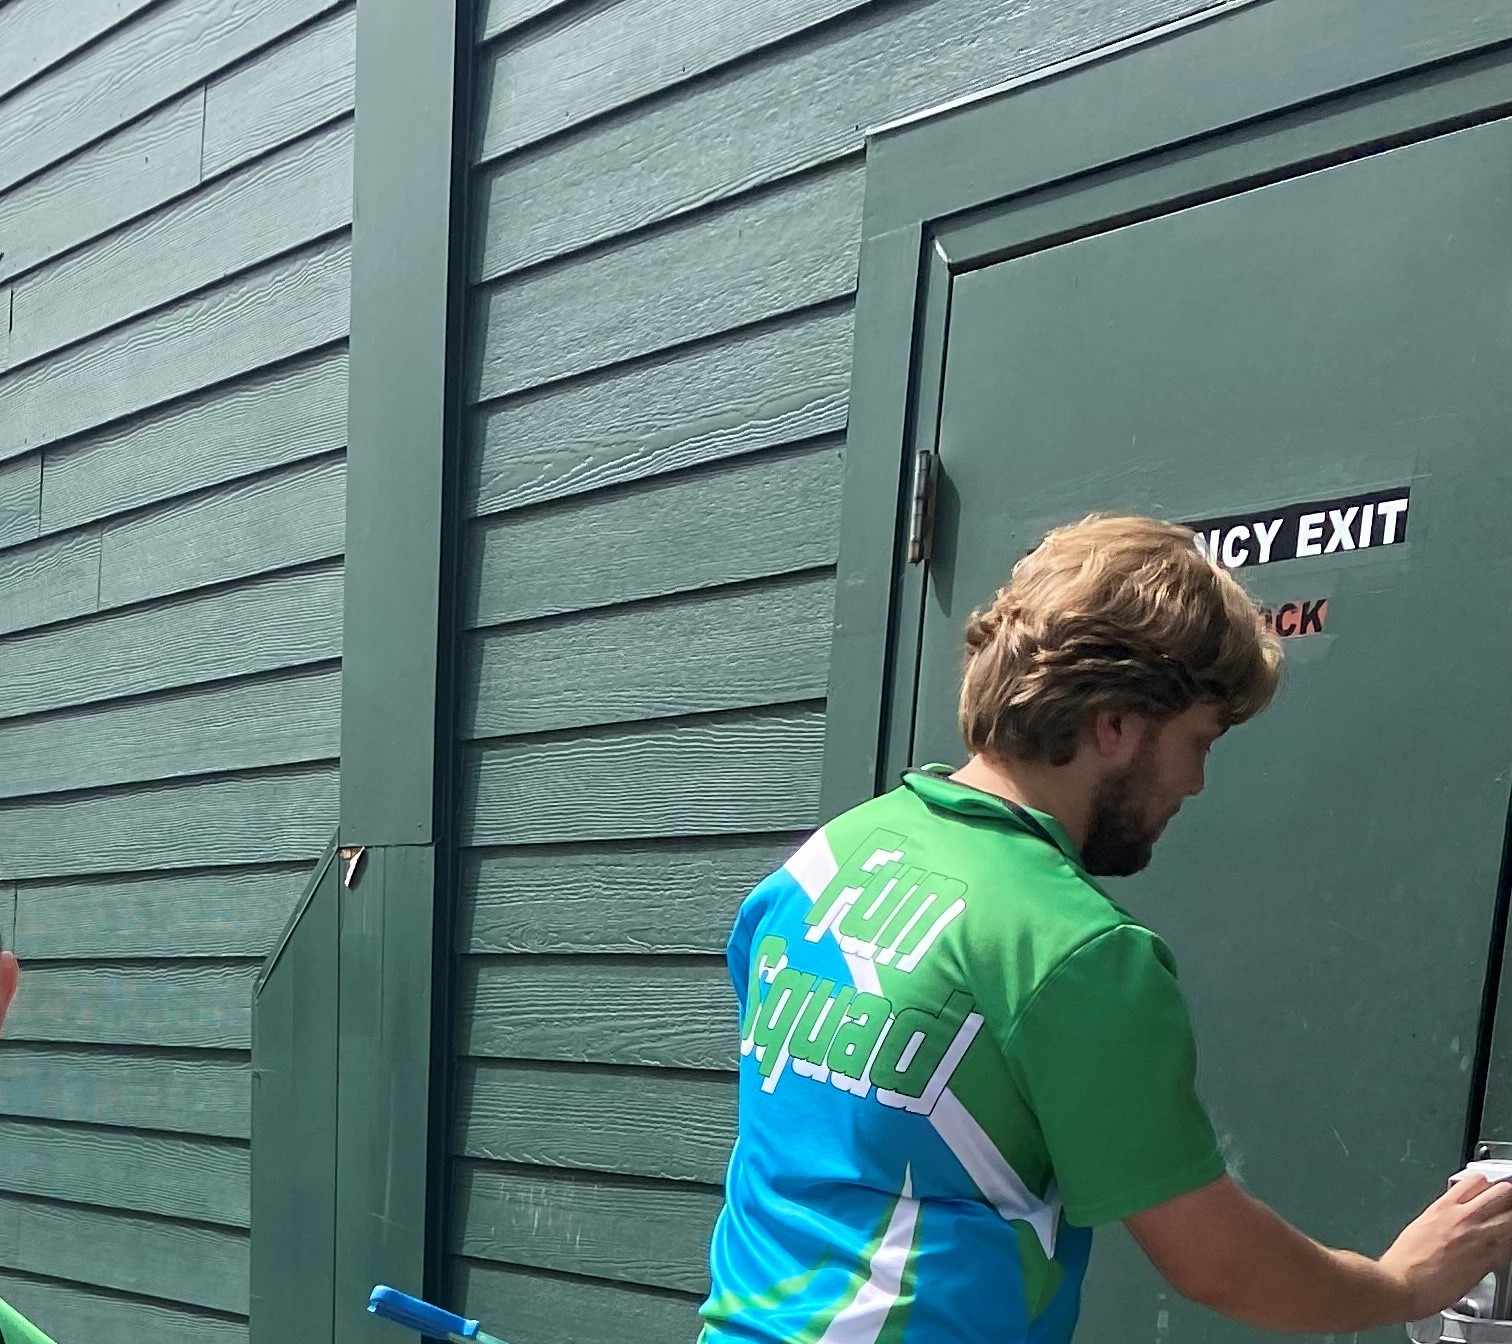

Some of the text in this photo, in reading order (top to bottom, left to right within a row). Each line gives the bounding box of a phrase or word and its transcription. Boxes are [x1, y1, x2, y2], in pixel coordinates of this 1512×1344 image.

[1193, 498, 1409, 568] NCY EXIT
[802, 826, 969, 974] Fun
[740, 934, 985, 1117] Squad
